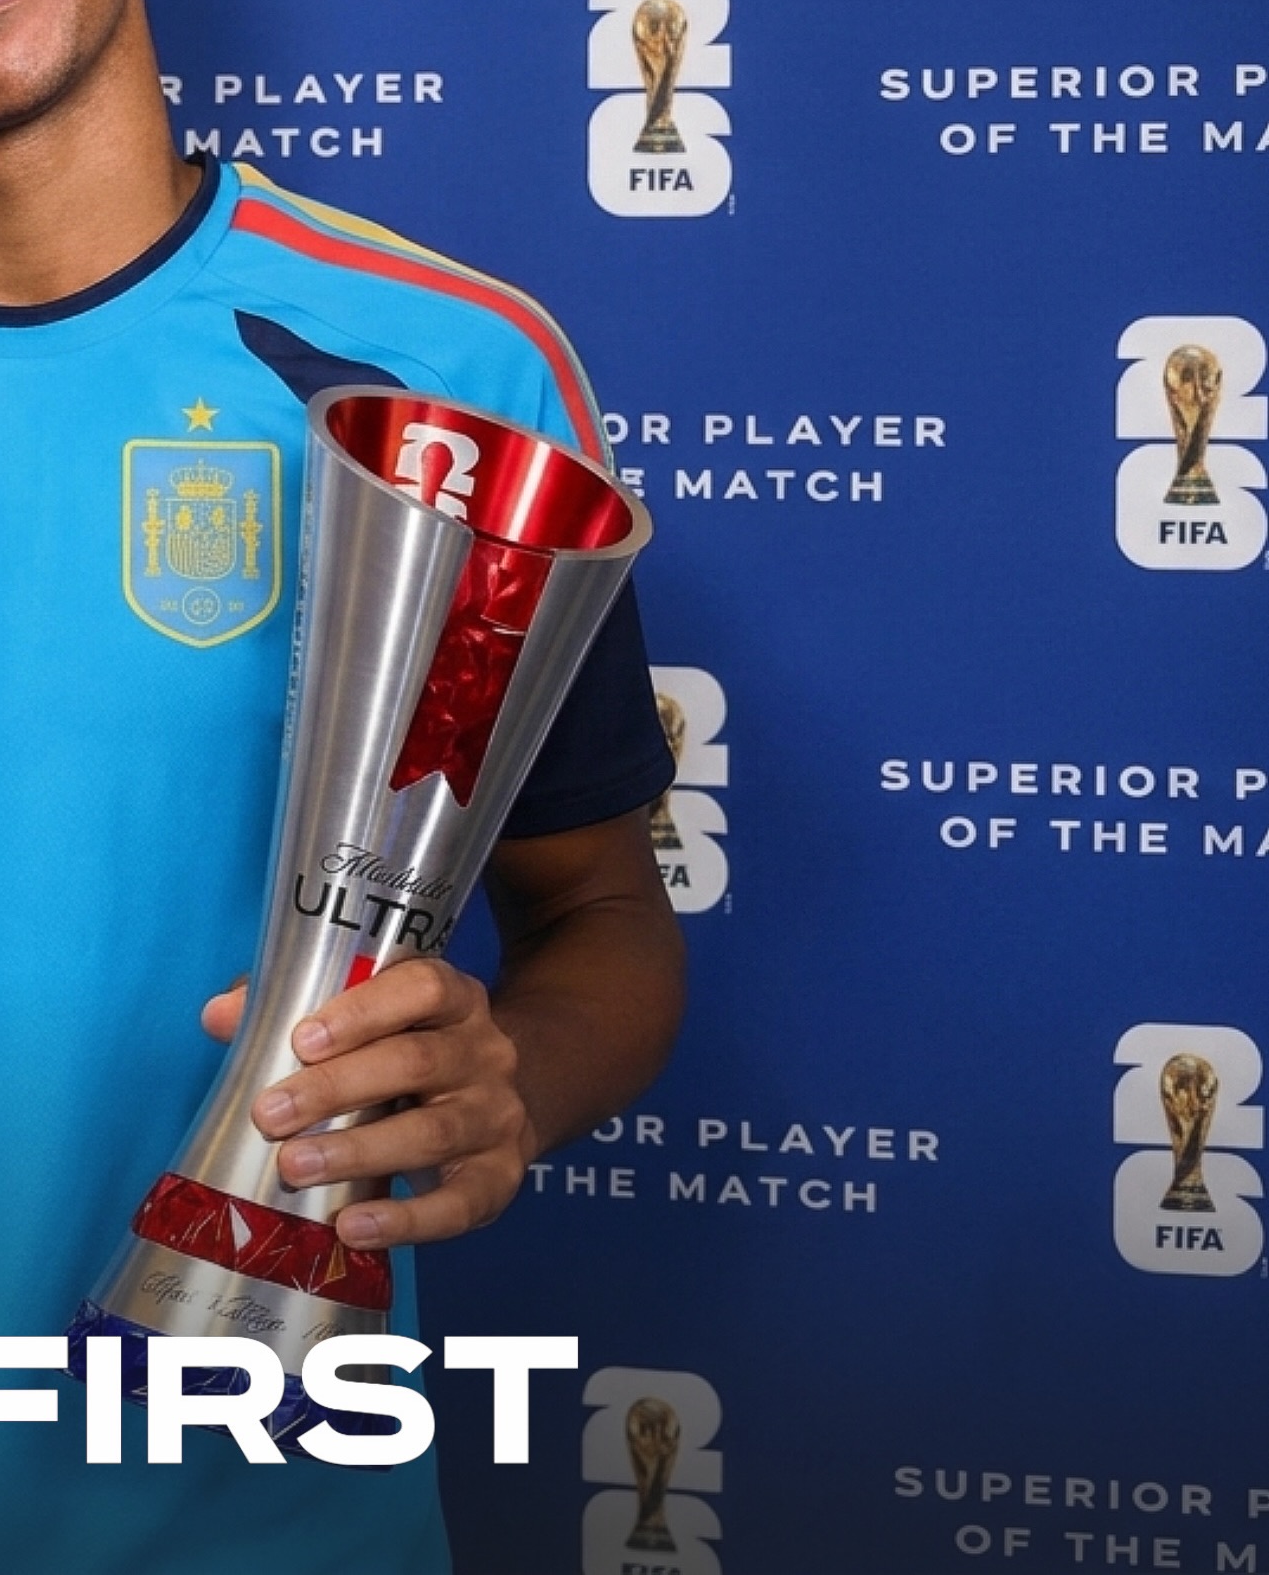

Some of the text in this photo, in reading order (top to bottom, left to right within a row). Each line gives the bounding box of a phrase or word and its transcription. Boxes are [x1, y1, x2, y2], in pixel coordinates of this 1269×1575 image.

[216, 73, 442, 103] PLAYER
[881, 66, 1198, 99] SUPERIOR
[186, 128, 381, 157] MATCH
[941, 123, 1167, 154] OF THE
[629, 168, 693, 192] FIFA
[705, 415, 945, 446] PLAYER
[677, 470, 881, 501] MATCH
[1159, 521, 1228, 545] FIFA
[881, 760, 1198, 797] SUPERIOR
[941, 817, 1167, 852] OF THE
[700, 1120, 938, 1160] PLAYER
[528, 1164, 875, 1212] THE MATCH
[1155, 1225, 1224, 1251] FIFA
[895, 1467, 1211, 1515] SUPERIOR
[956, 1525, 1030, 1556] OF
[1065, 1533, 1180, 1567] THE
